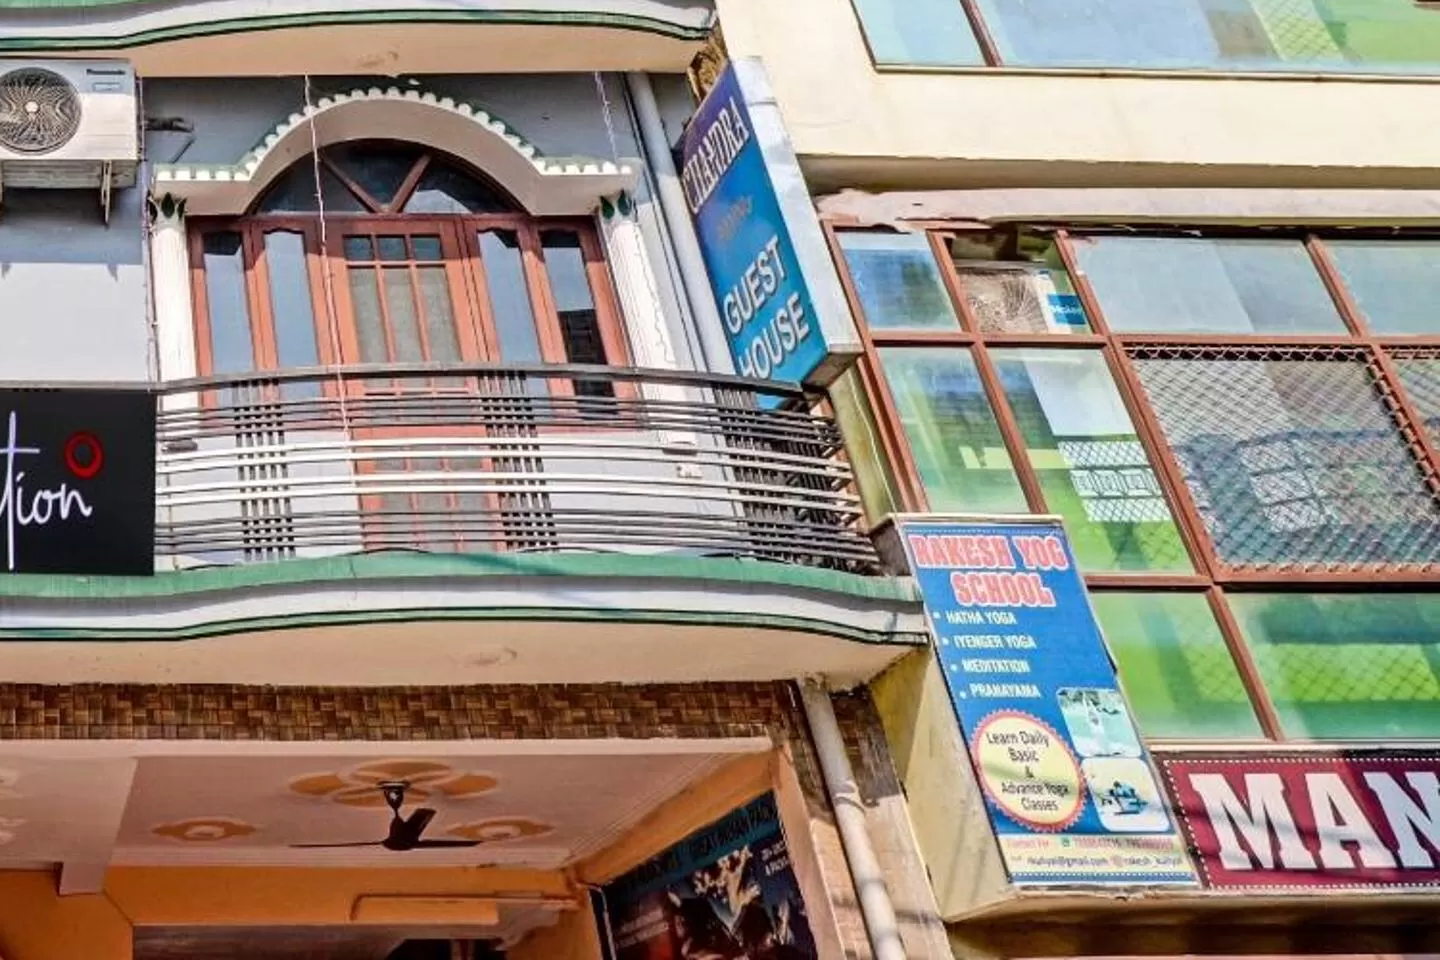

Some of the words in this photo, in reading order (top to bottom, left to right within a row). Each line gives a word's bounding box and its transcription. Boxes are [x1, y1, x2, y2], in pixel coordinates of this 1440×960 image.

[723, 234, 786, 335] GUEST
[738, 292, 809, 379] HOUSE
[908, 534, 1016, 569] RAKESH
[950, 571, 1057, 607] SCHOOL
[946, 610, 985, 625] HATHA
[986, 611, 1017, 625] YOGA
[1007, 635, 1037, 649] YOGA
[962, 658, 1031, 673] MEDITATION
[969, 683, 1041, 698] PRANAYAMA
[986, 731, 1018, 745] Learn
[1019, 730, 1049, 748] Daily
[1008, 746, 1039, 762] Basic
[1001, 781, 1043, 795] Advance
[1044, 782, 1069, 798] Yoga
[1021, 796, 1059, 811] Classes
